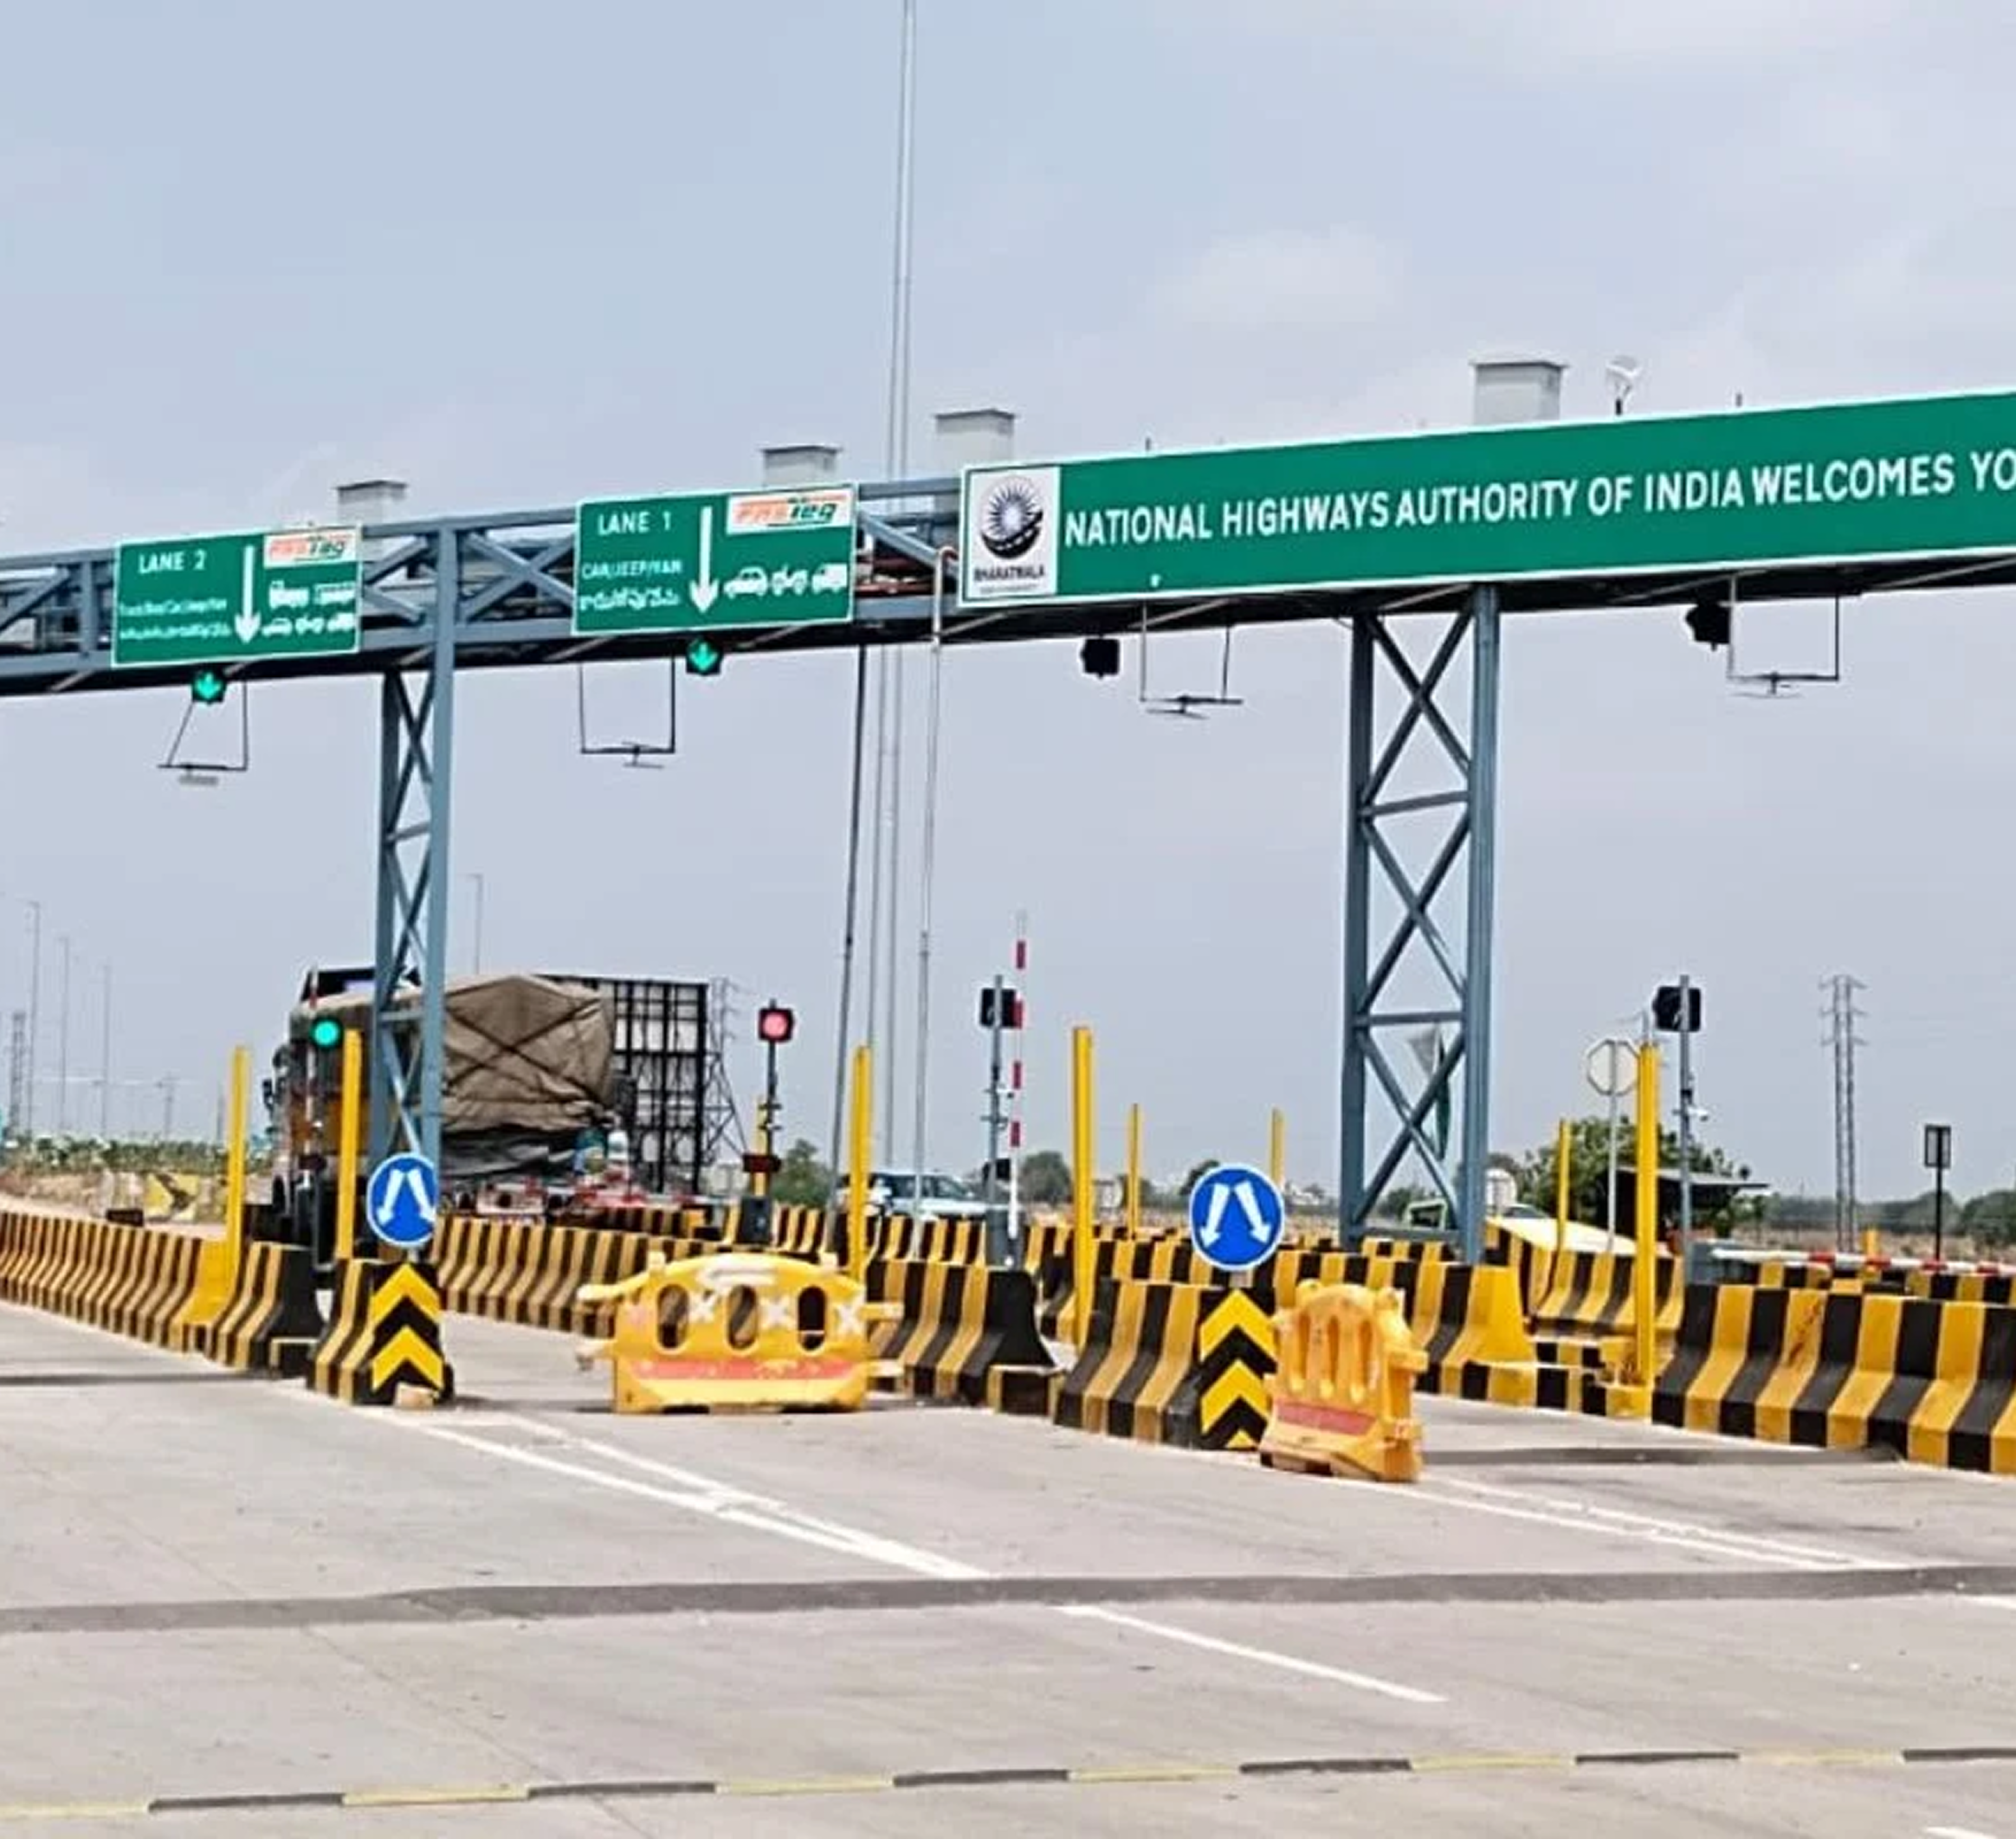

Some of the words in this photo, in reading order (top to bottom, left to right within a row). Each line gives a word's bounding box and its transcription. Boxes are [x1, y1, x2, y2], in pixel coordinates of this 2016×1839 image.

[1064, 503, 1212, 547] NATIONAL
[1223, 490, 1390, 537] HIGHWAYS
[1395, 479, 1579, 527] AUTHORITY
[1587, 475, 1633, 517] OF
[1645, 468, 1745, 512] INDIA
[1752, 453, 1955, 505] WELCOMES
[598, 511, 650, 535] LANE
[662, 511, 672, 530] 1
[138, 552, 184, 574] LANE
[194, 549, 206, 570] 2
